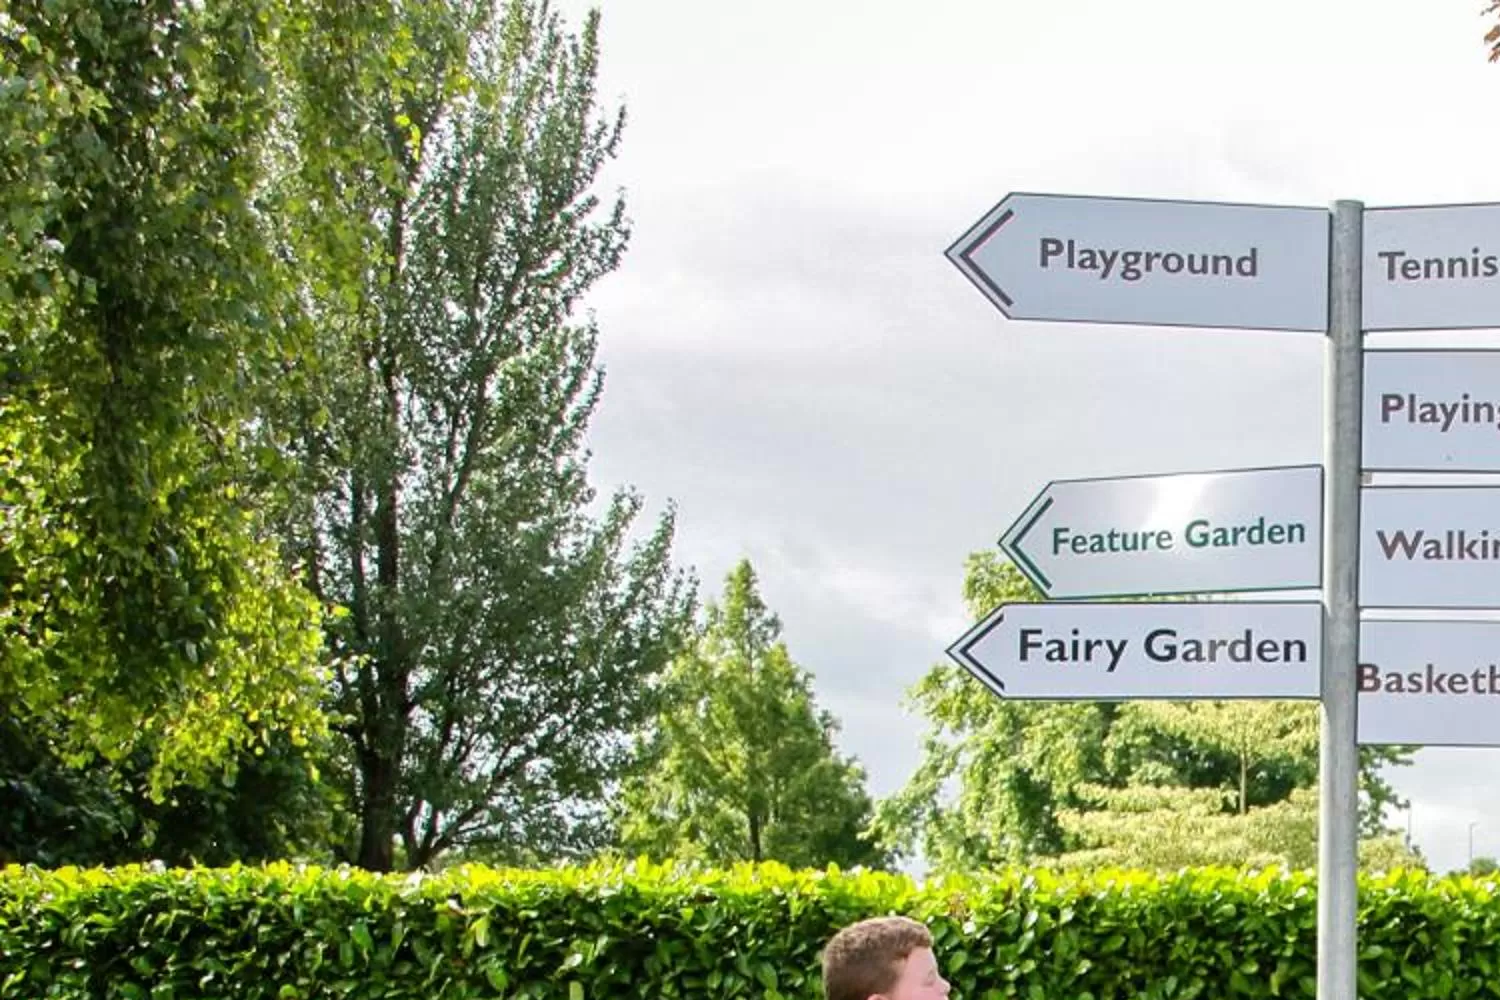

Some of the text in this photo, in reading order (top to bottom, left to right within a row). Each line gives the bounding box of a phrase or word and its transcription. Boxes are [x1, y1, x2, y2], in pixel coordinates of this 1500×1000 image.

[1039, 237, 1258, 281] Playground
[1378, 247, 1499, 281] Tennis
[1052, 516, 1305, 555] Feature Garden
[1019, 628, 1307, 672] Fairy Garden
